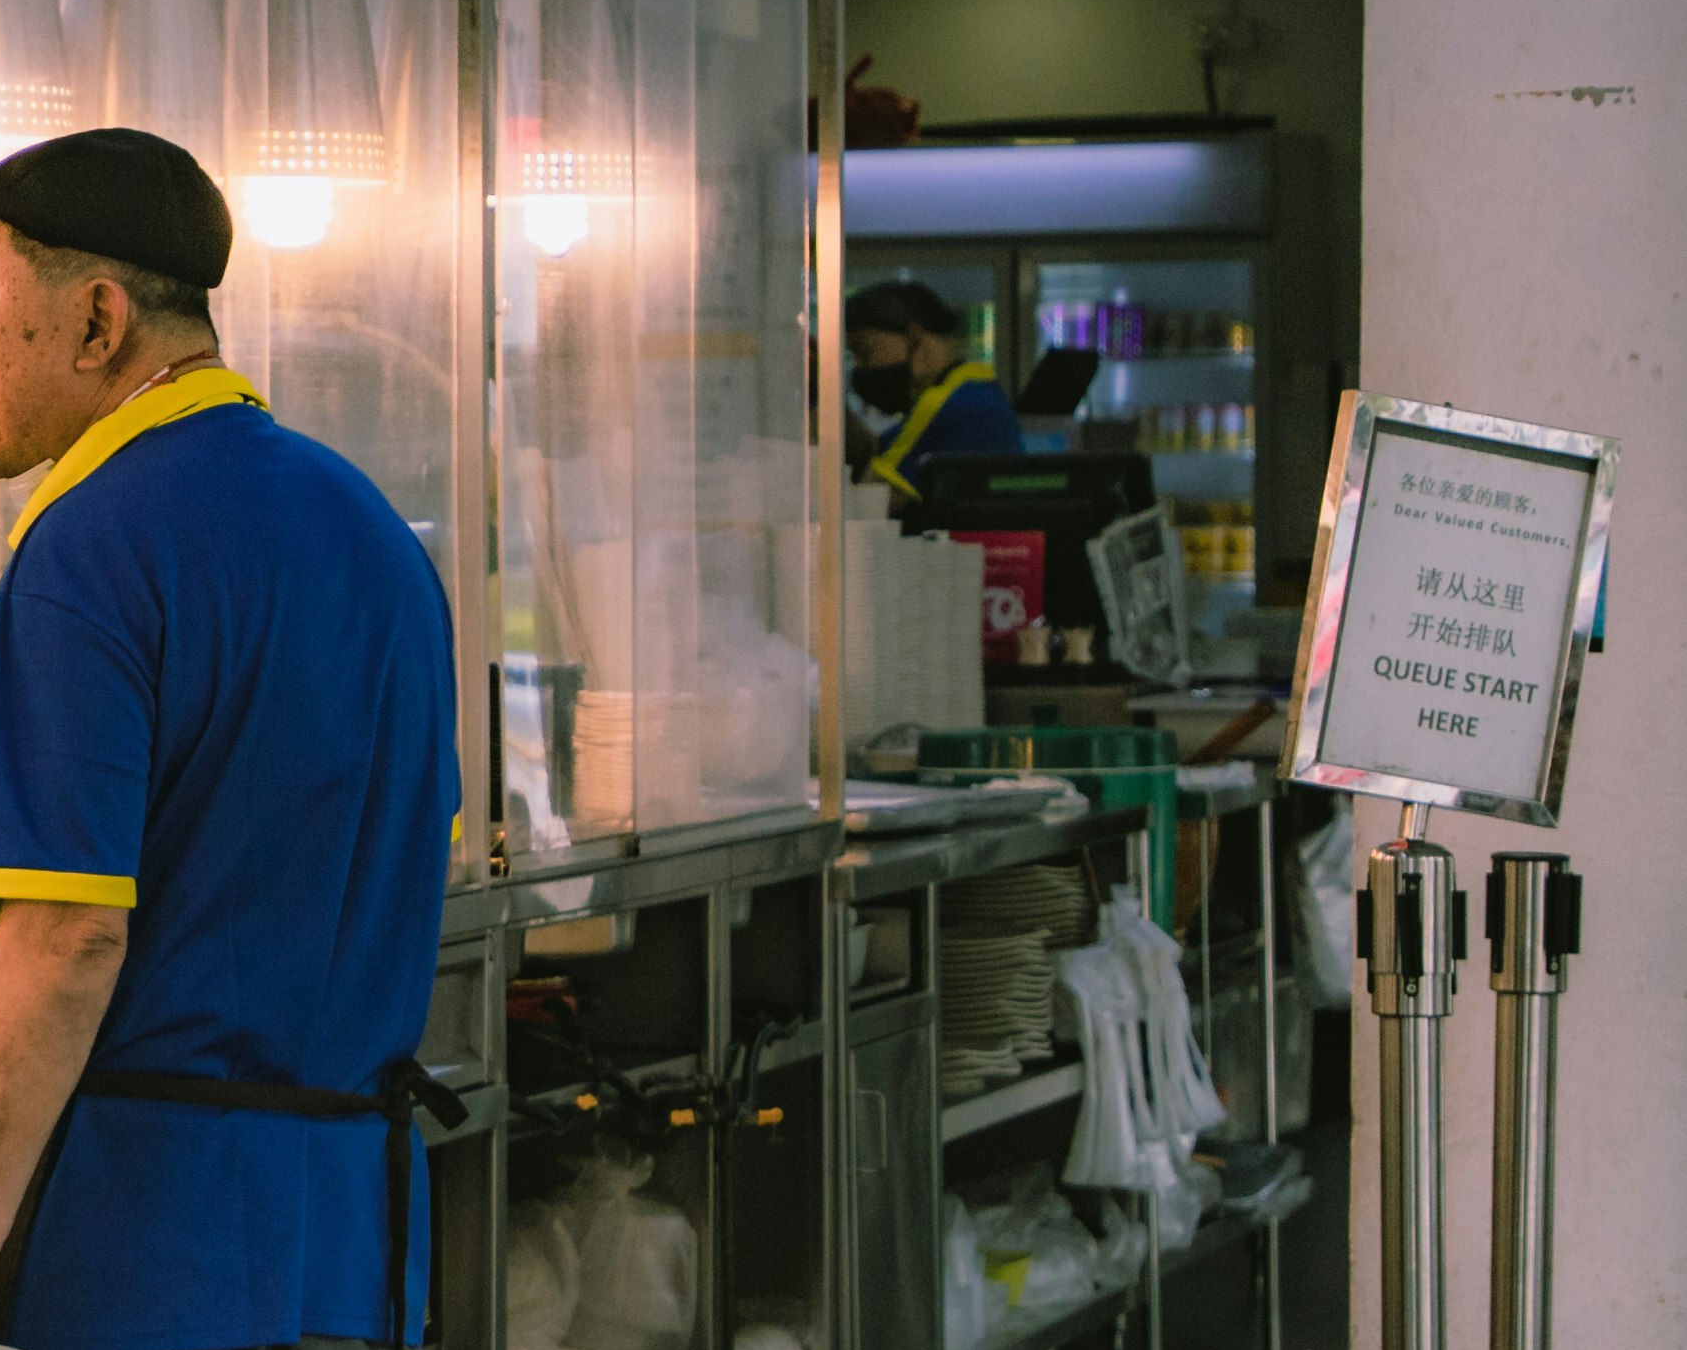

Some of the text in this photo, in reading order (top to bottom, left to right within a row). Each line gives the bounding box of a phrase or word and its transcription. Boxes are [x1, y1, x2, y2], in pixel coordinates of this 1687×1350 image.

[1394, 503, 1571, 549] Dear Valued Customers,
[1416, 566, 1525, 612] 请从这里
[1408, 613, 1517, 657] 开始排队
[1373, 655, 1539, 705] QUEUE START
[1418, 707, 1480, 738] HERE
